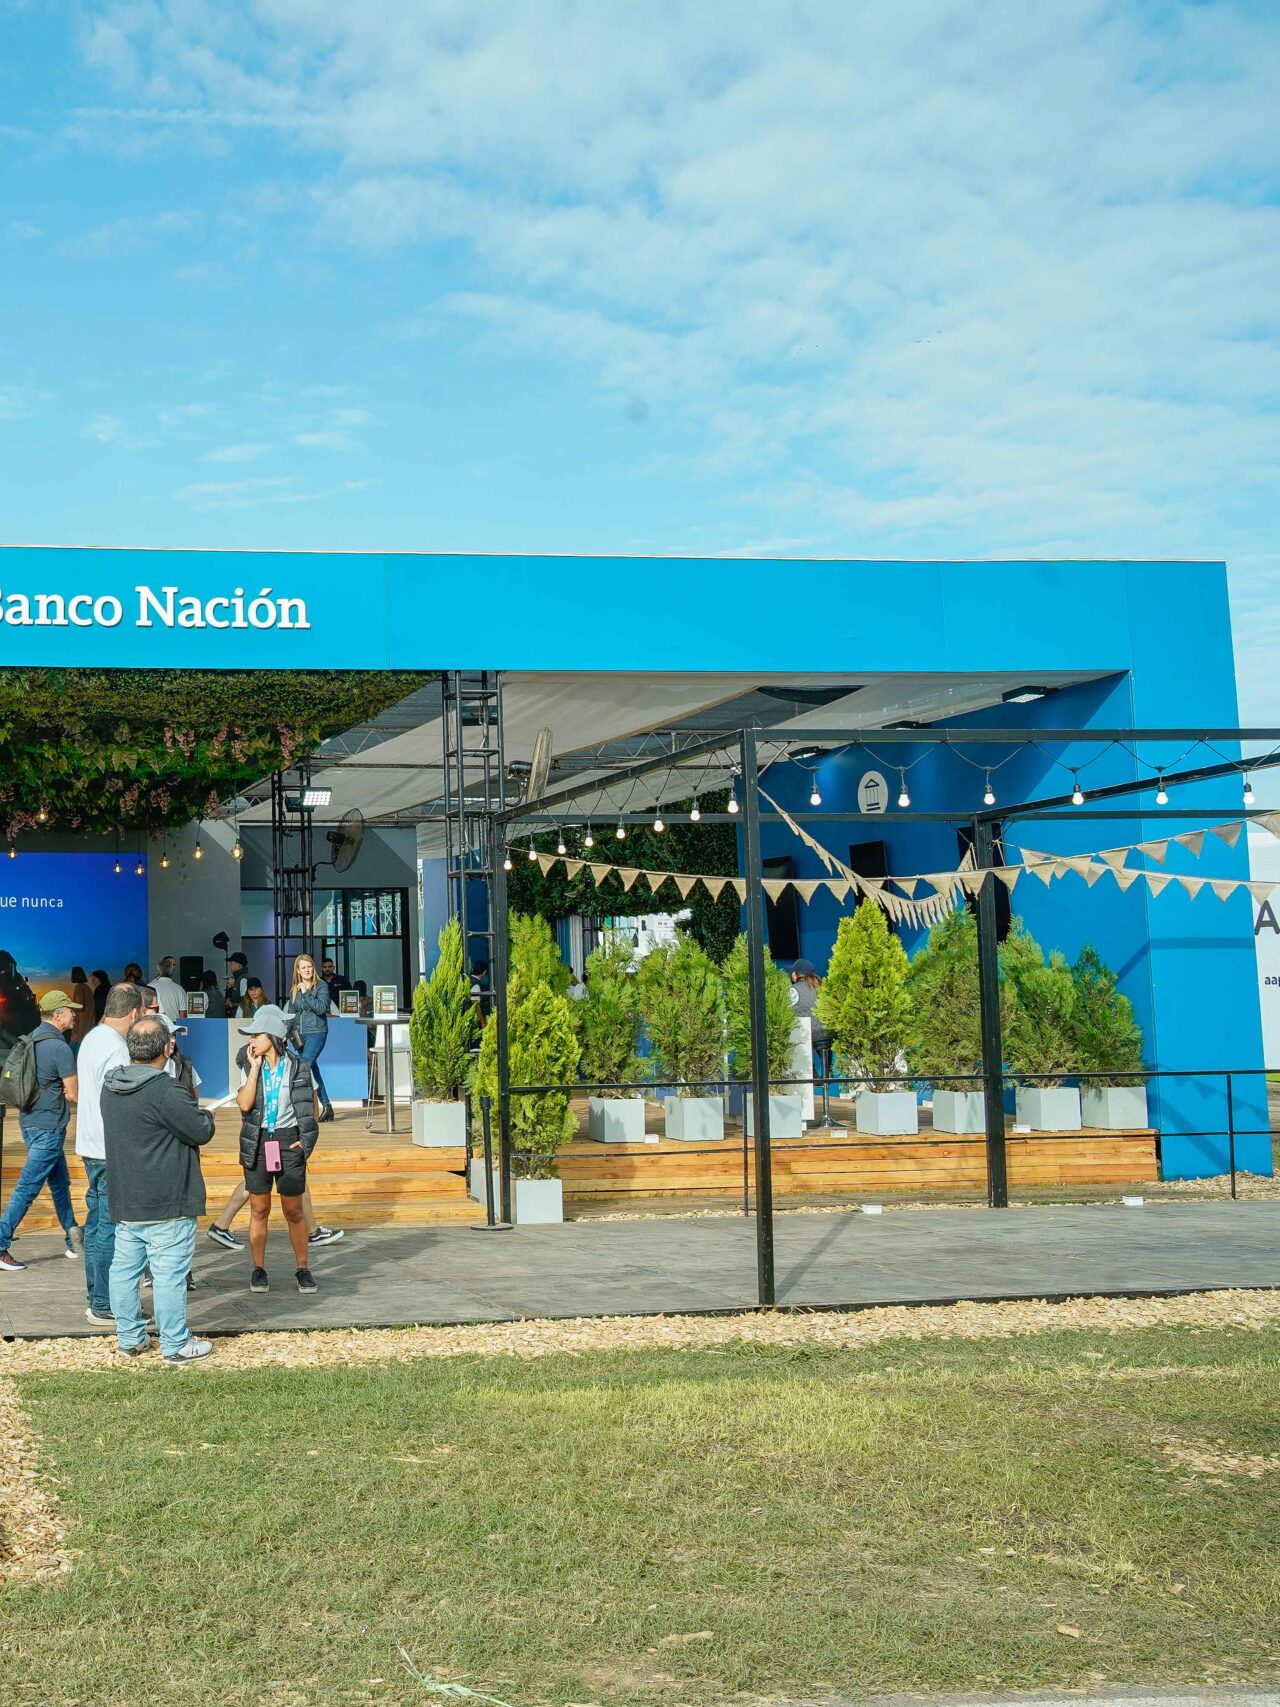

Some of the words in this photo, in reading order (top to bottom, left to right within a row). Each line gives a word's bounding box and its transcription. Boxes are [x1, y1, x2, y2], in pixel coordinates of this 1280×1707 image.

[135, 585, 311, 629] Nación
[21, 896, 63, 908] nunca
[1254, 900, 1280, 935] A
[1264, 976, 1280, 987] aa
